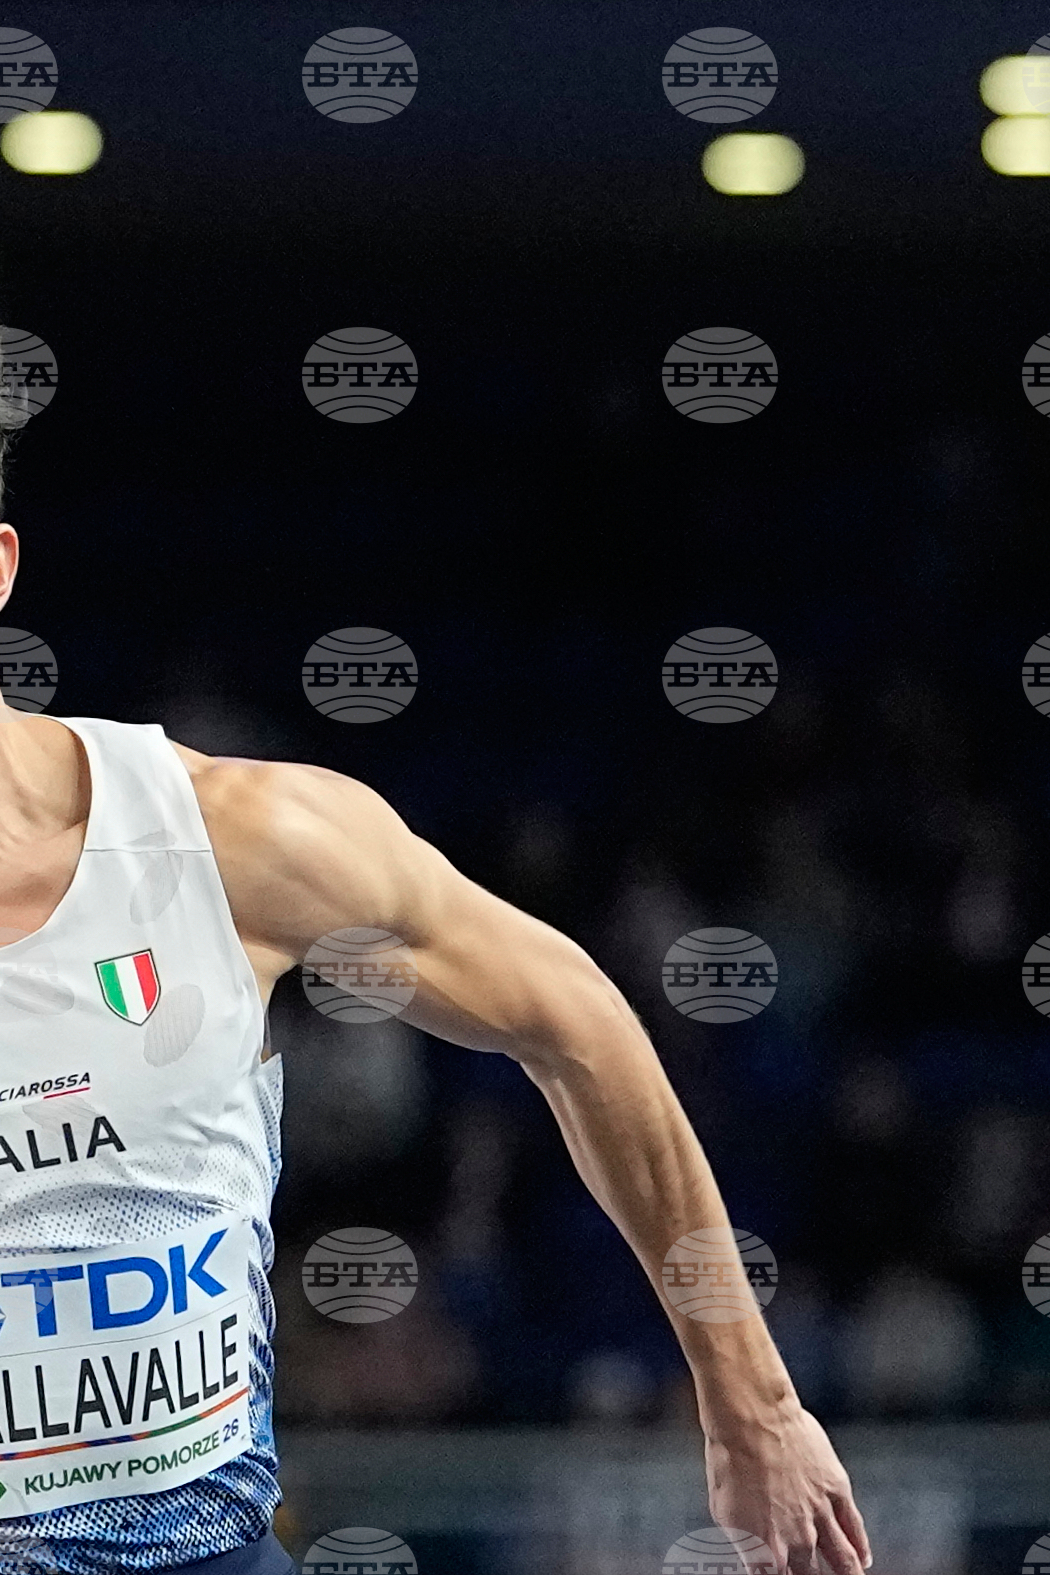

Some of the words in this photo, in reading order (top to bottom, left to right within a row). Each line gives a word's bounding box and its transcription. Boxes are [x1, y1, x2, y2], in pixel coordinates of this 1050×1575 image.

[0, 1227, 229, 1337] TDK
[24, 1461, 122, 1495] KUJAWY
[128, 1430, 220, 1477] POMORZE
[222, 1418, 240, 1443] 26
